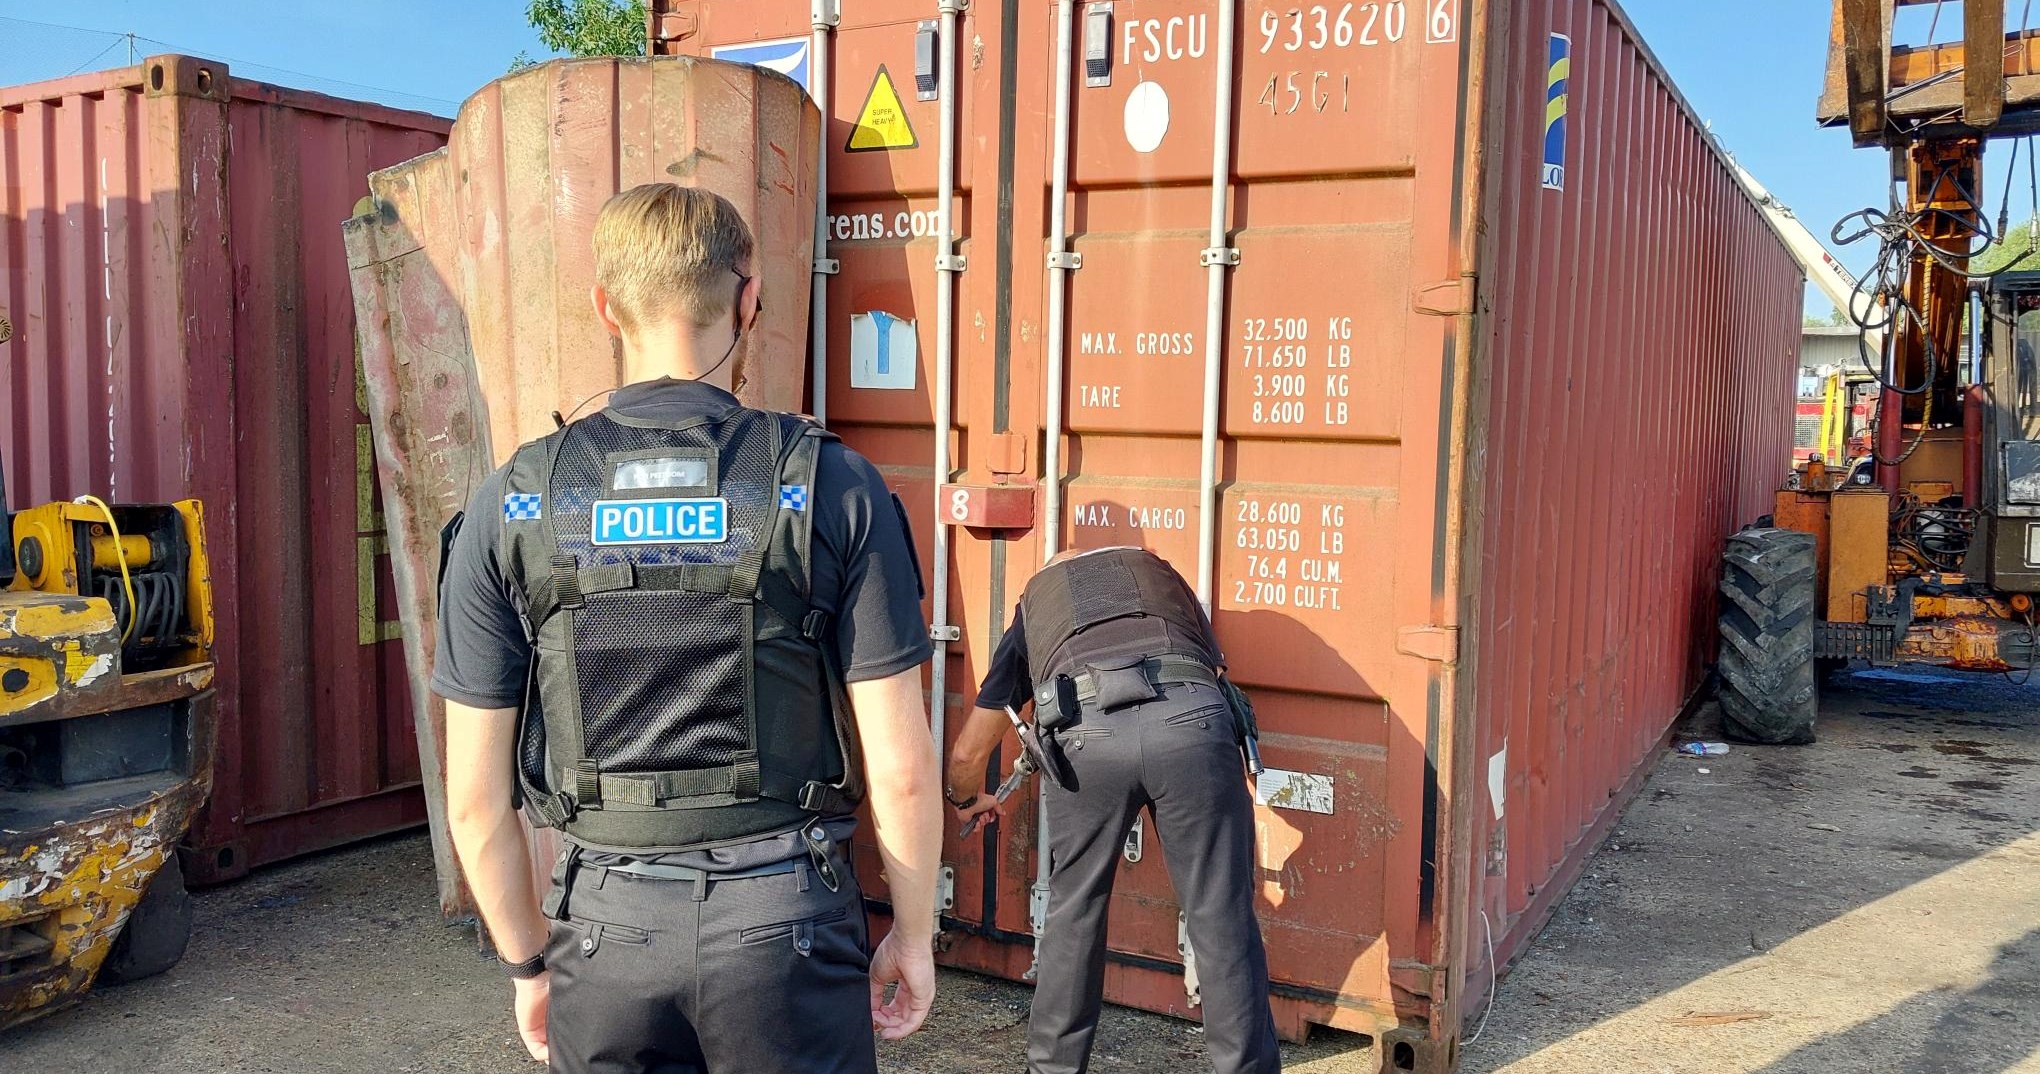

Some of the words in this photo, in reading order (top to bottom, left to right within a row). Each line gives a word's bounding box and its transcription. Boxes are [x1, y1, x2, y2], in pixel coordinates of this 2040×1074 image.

[1123, 13, 1207, 64] FSCU
[1259, 0, 1407, 54] 933620
[1431, 0, 1451, 39] 6
[1243, 317, 1308, 342] 32,500
[1328, 317, 1352, 340] KG
[1080, 332, 1123, 355] MAX.
[1135, 332, 1194, 355] GROSS
[1243, 345, 1307, 368] 71,650
[1327, 344, 1351, 368] LB
[1080, 385, 1121, 408] TARE
[1253, 374, 1306, 398] 3,900
[1326, 374, 1349, 397] KG
[1252, 400, 1305, 425] 8,600
[1324, 401, 1348, 425] LB
[951, 489, 969, 521] 8
[1074, 504, 1116, 528] MAX.
[1129, 506, 1186, 530] CARGO
[1321, 504, 1344, 527] KG
[602, 505, 717, 538] POLICE
[1320, 530, 1343, 554] LB
[1248, 555, 1287, 579] 76.4
[1300, 559, 1343, 584] CU.M.
[1293, 585, 1341, 611] CU.FT.
